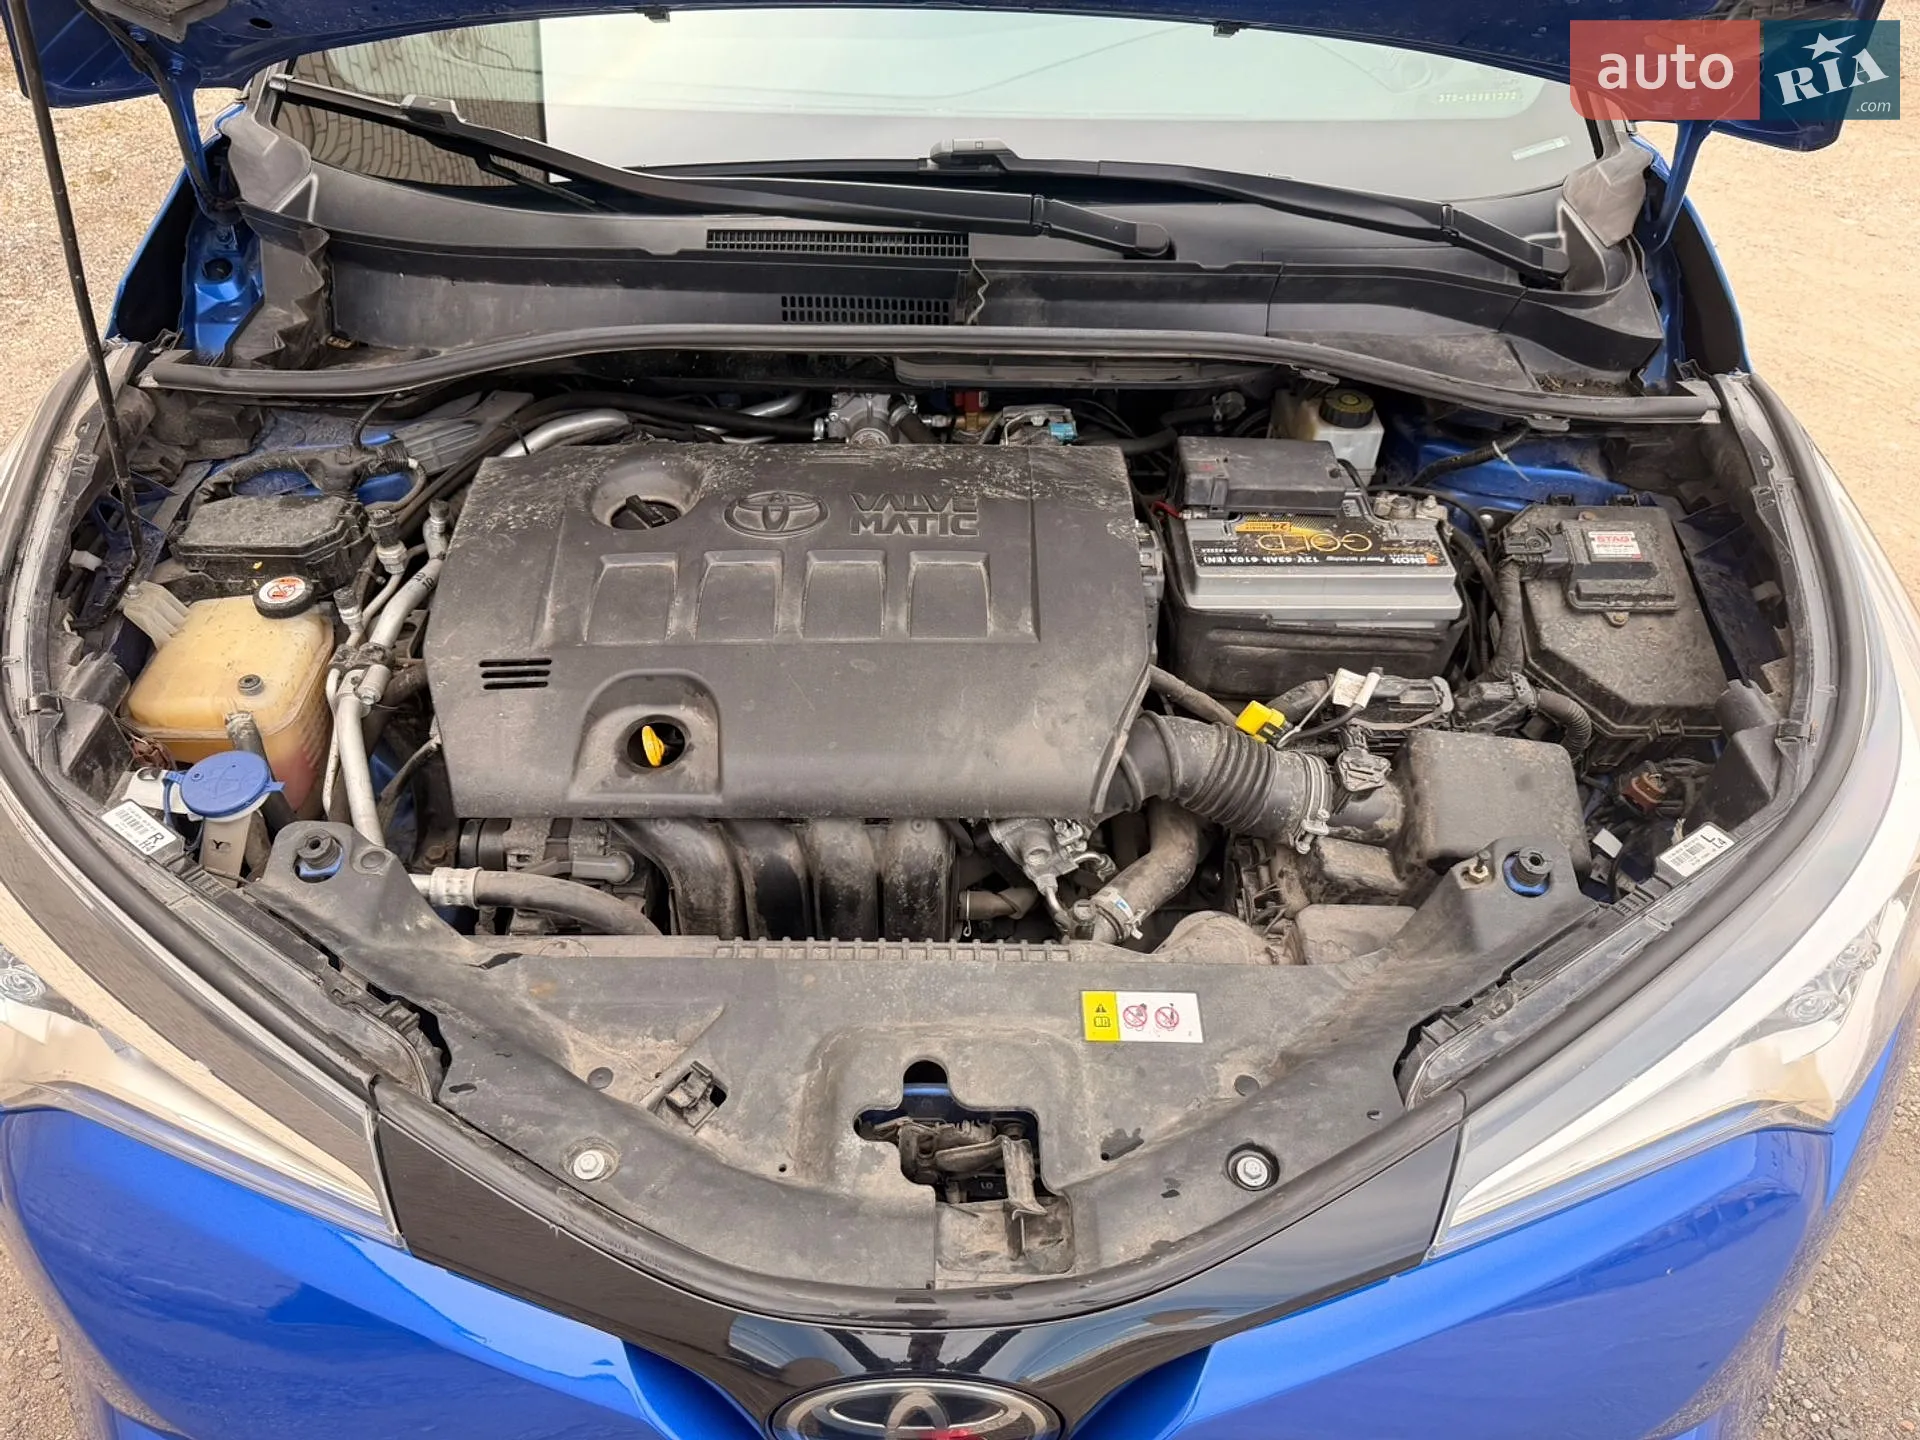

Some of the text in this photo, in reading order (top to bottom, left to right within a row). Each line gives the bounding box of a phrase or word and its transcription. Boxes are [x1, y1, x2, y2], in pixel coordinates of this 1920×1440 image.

[851, 492, 979, 513] VALVE
[851, 513, 980, 536] MATIC
[1258, 533, 1373, 552] GOLD
[150, 831, 165, 845] R
[1700, 834, 1716, 843] L
